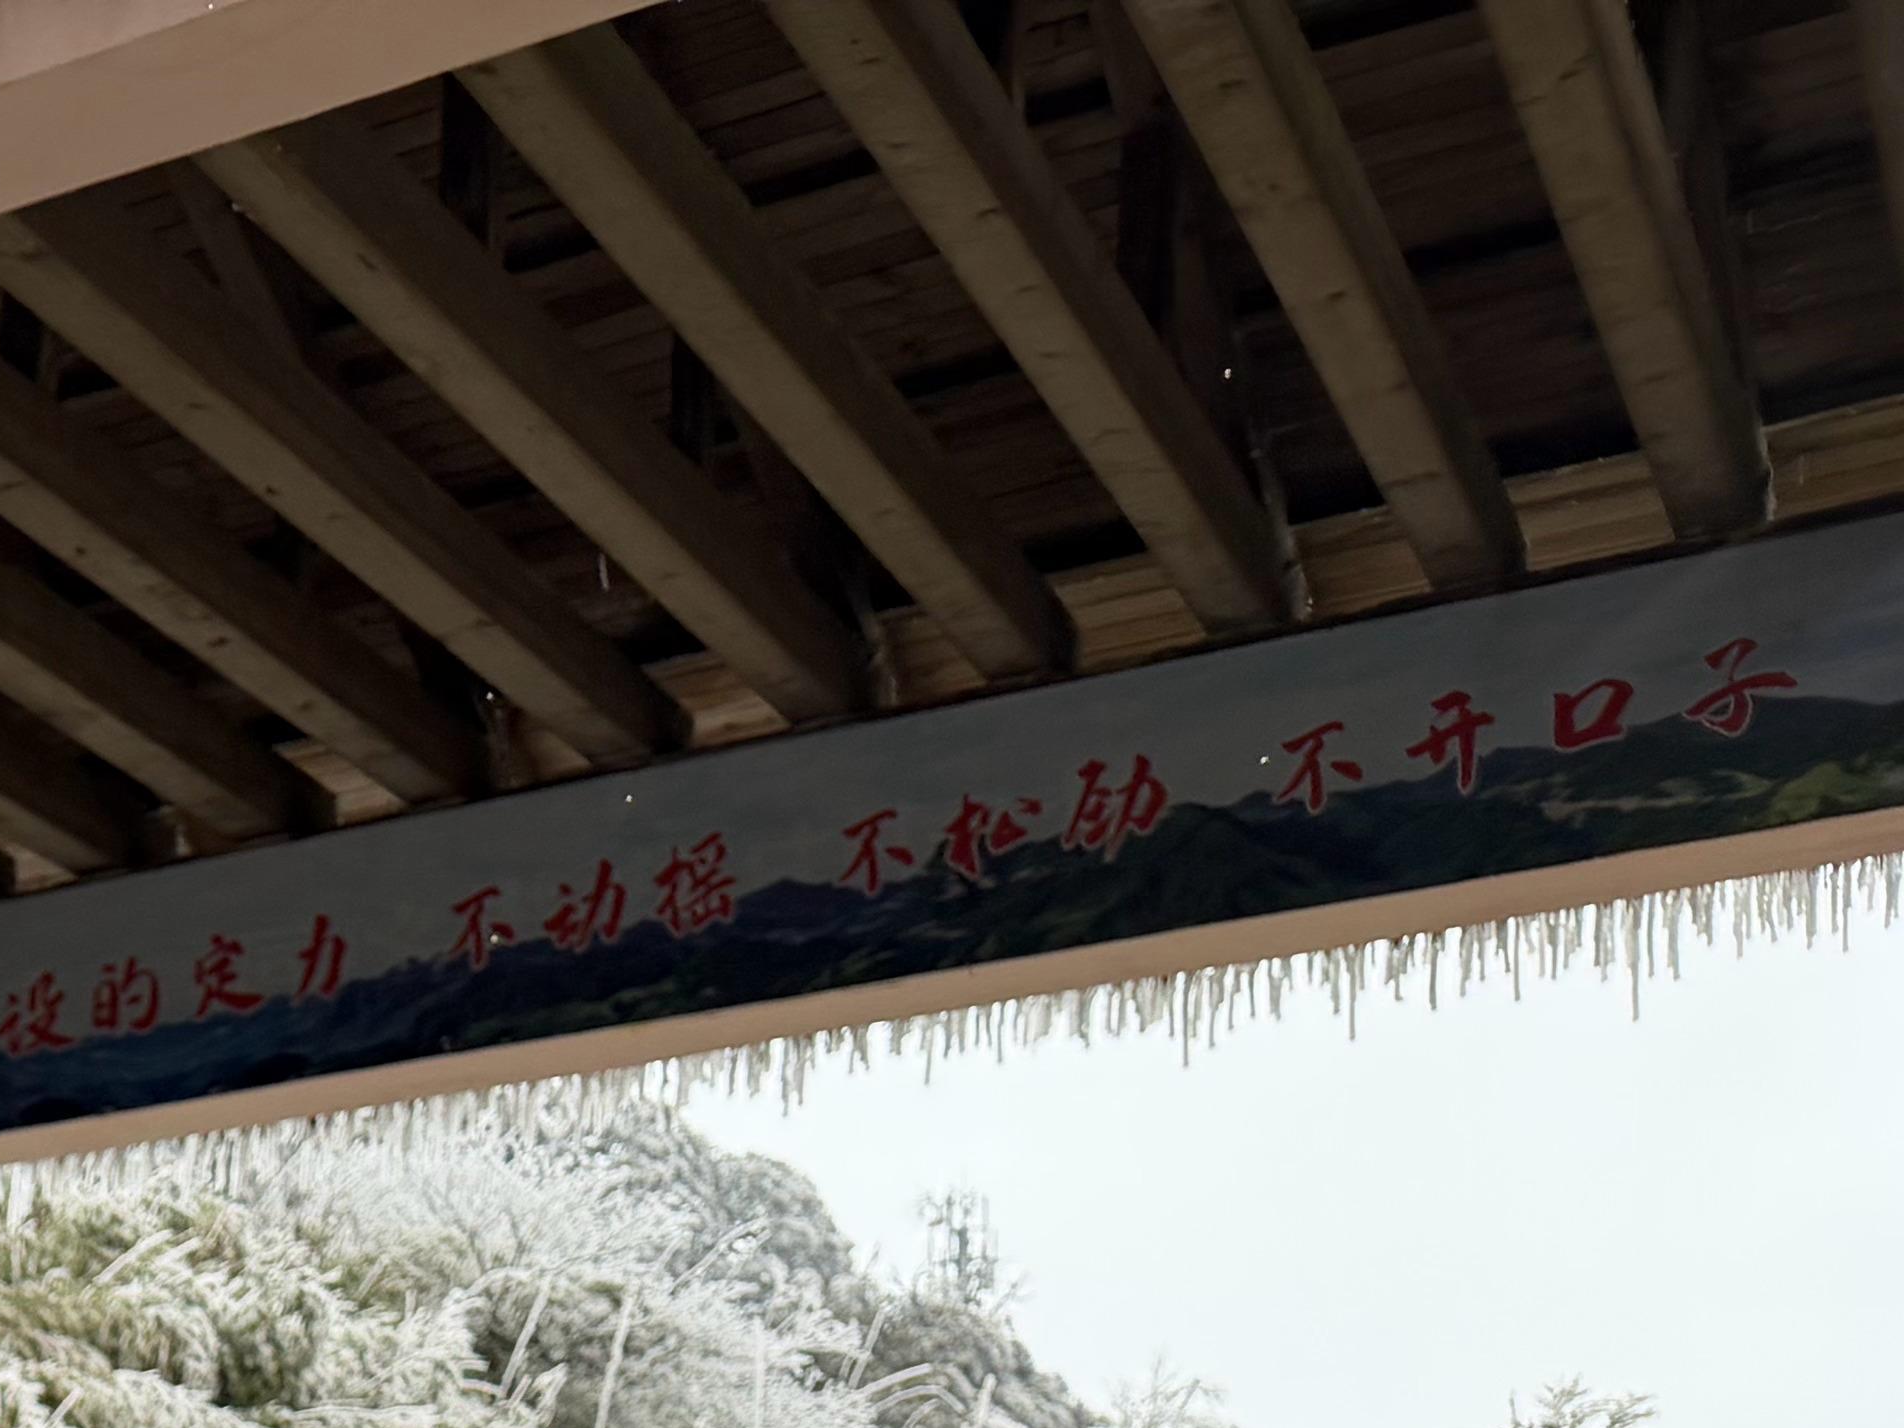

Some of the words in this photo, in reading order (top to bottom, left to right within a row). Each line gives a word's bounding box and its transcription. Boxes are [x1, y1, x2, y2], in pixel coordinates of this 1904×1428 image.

[448, 832, 739, 971] 不动摇
[837, 753, 1171, 895] 不松劲
[1275, 637, 1799, 816] 不开口子
